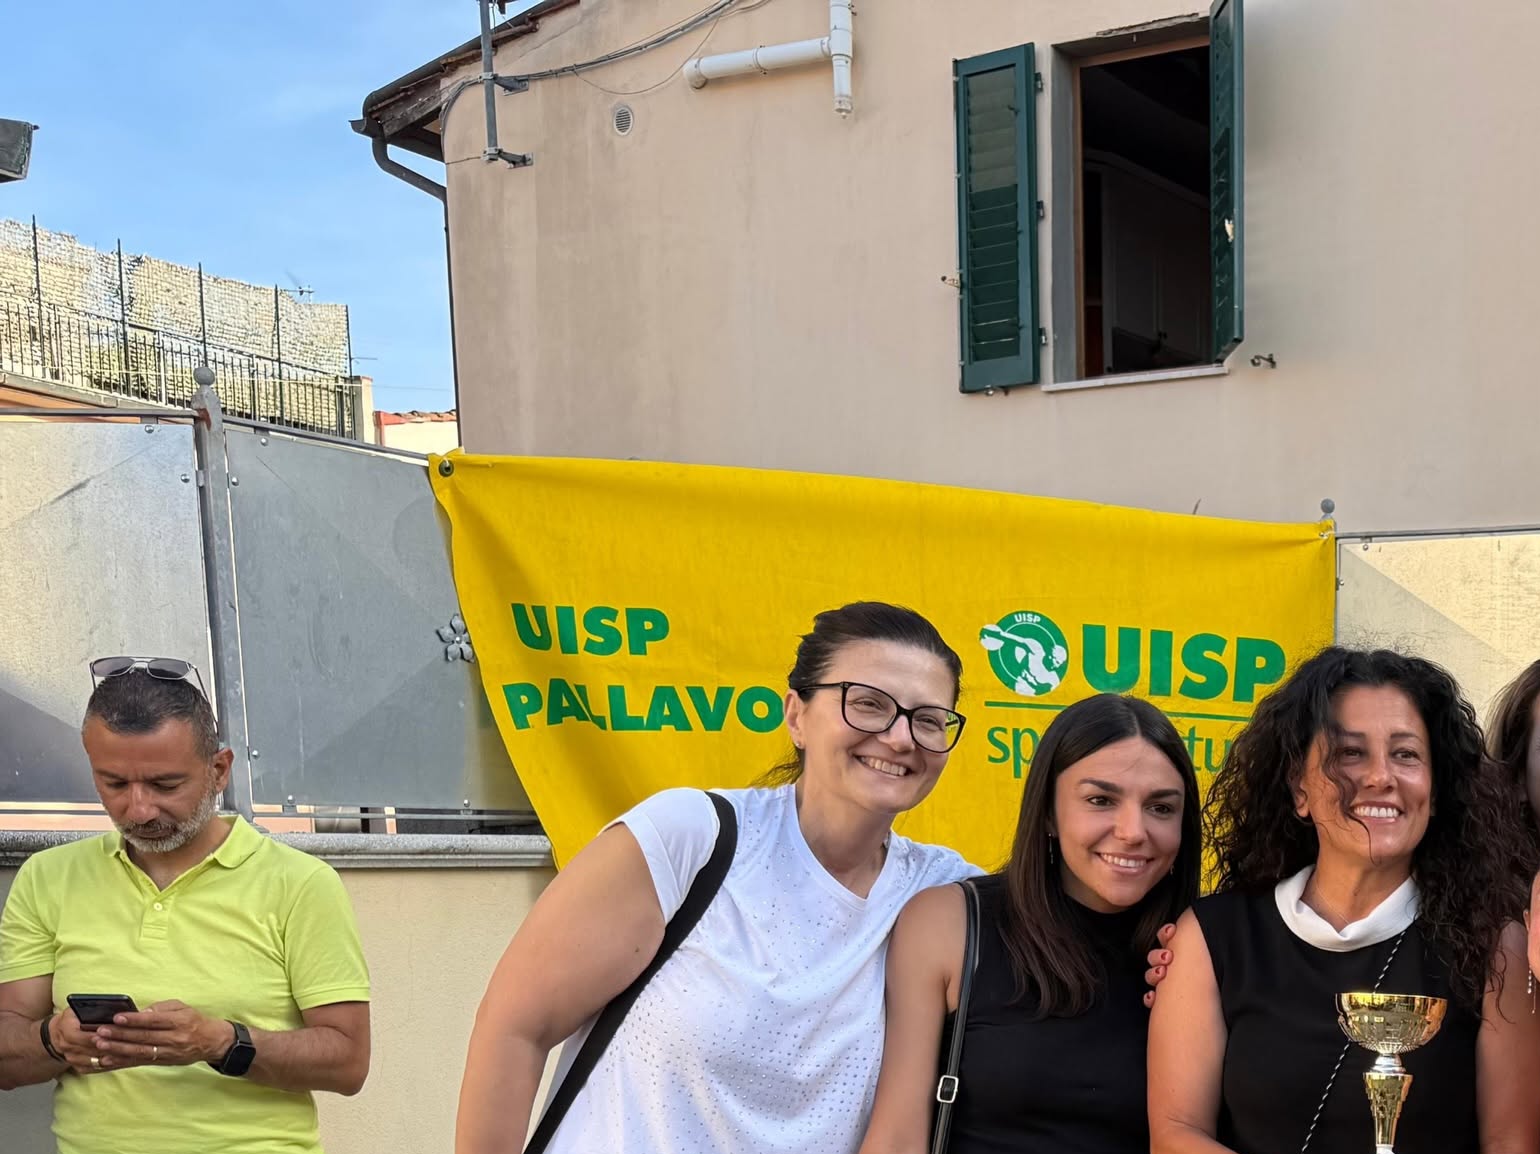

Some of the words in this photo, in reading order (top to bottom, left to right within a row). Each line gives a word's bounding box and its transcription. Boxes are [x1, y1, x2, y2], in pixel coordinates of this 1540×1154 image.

[511, 603, 670, 656] UISP
[1013, 612, 1042, 623] UISP
[1082, 623, 1286, 703] UISP
[502, 678, 785, 733] PALLAVO
